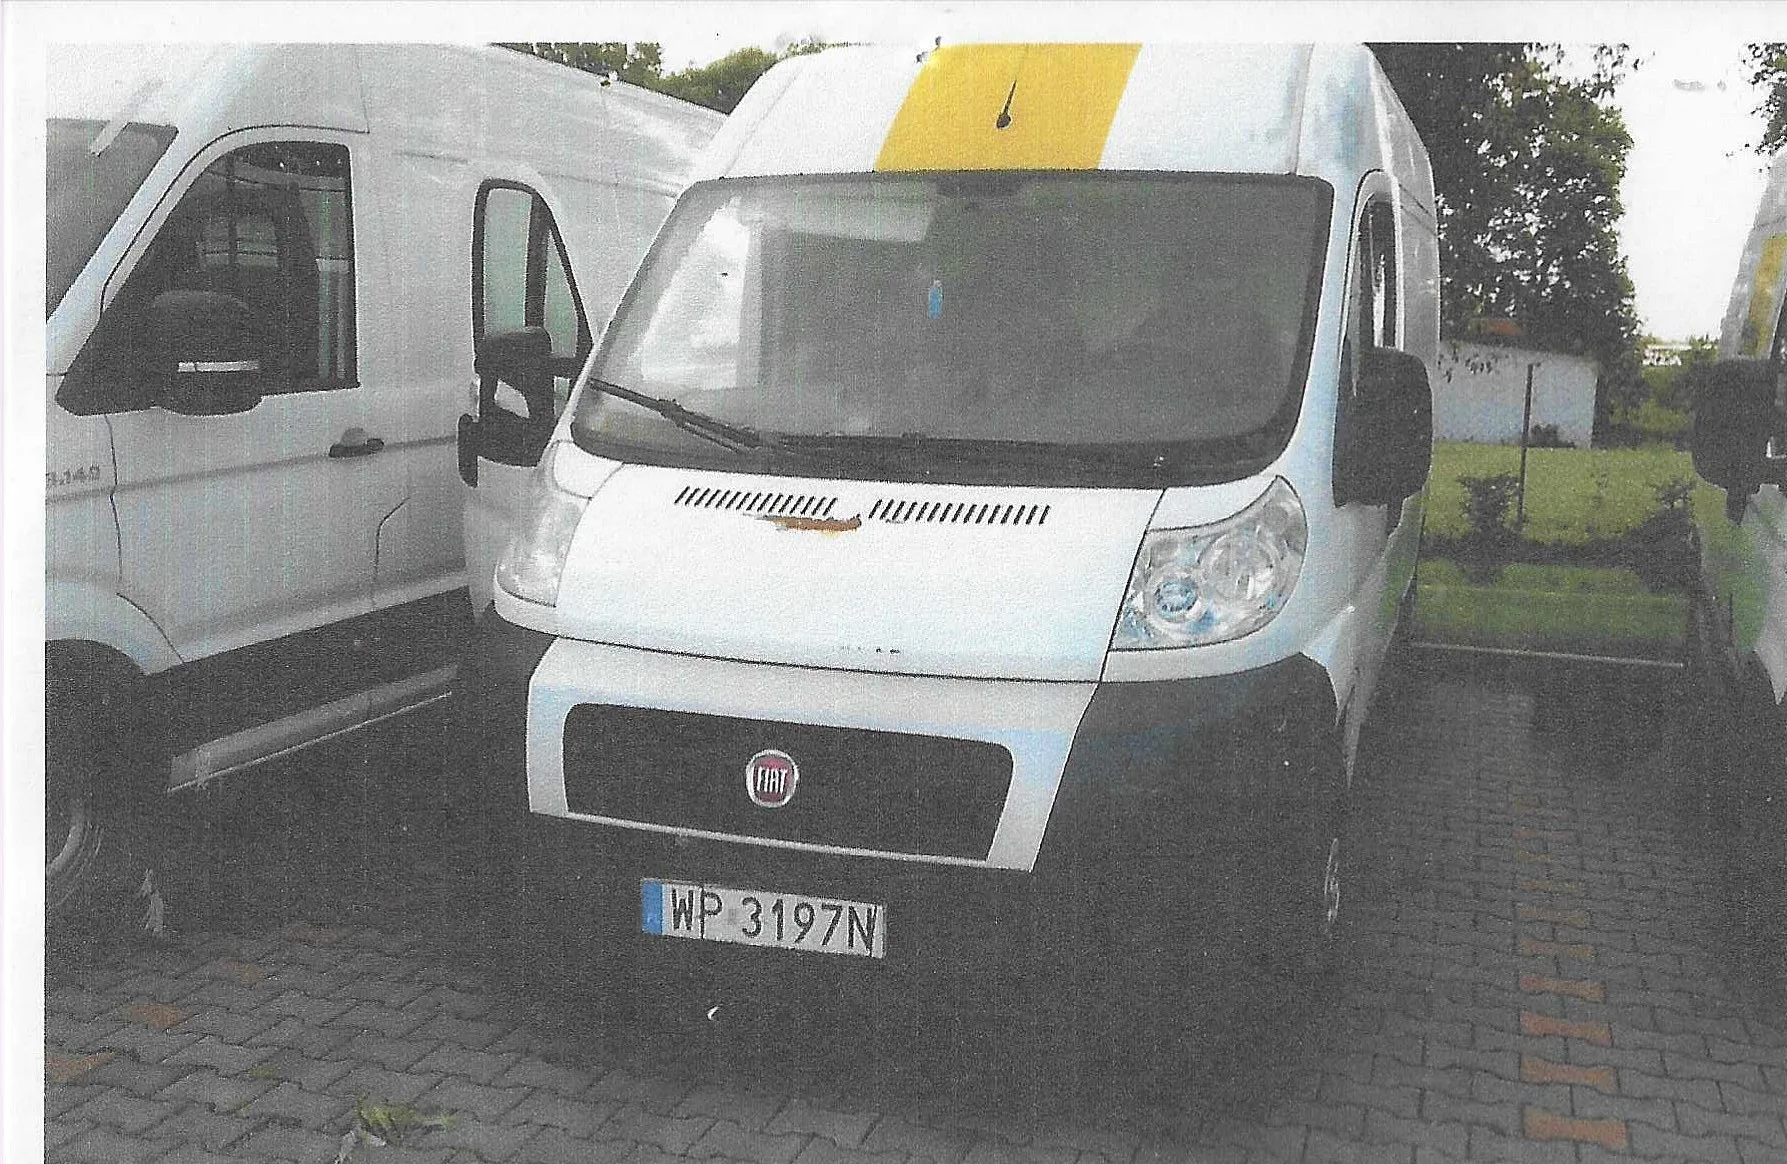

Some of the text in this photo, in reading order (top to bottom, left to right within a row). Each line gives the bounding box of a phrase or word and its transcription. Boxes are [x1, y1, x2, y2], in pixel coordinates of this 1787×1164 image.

[757, 765, 788, 794] FIAT
[671, 888, 877, 950] WP 3197N
